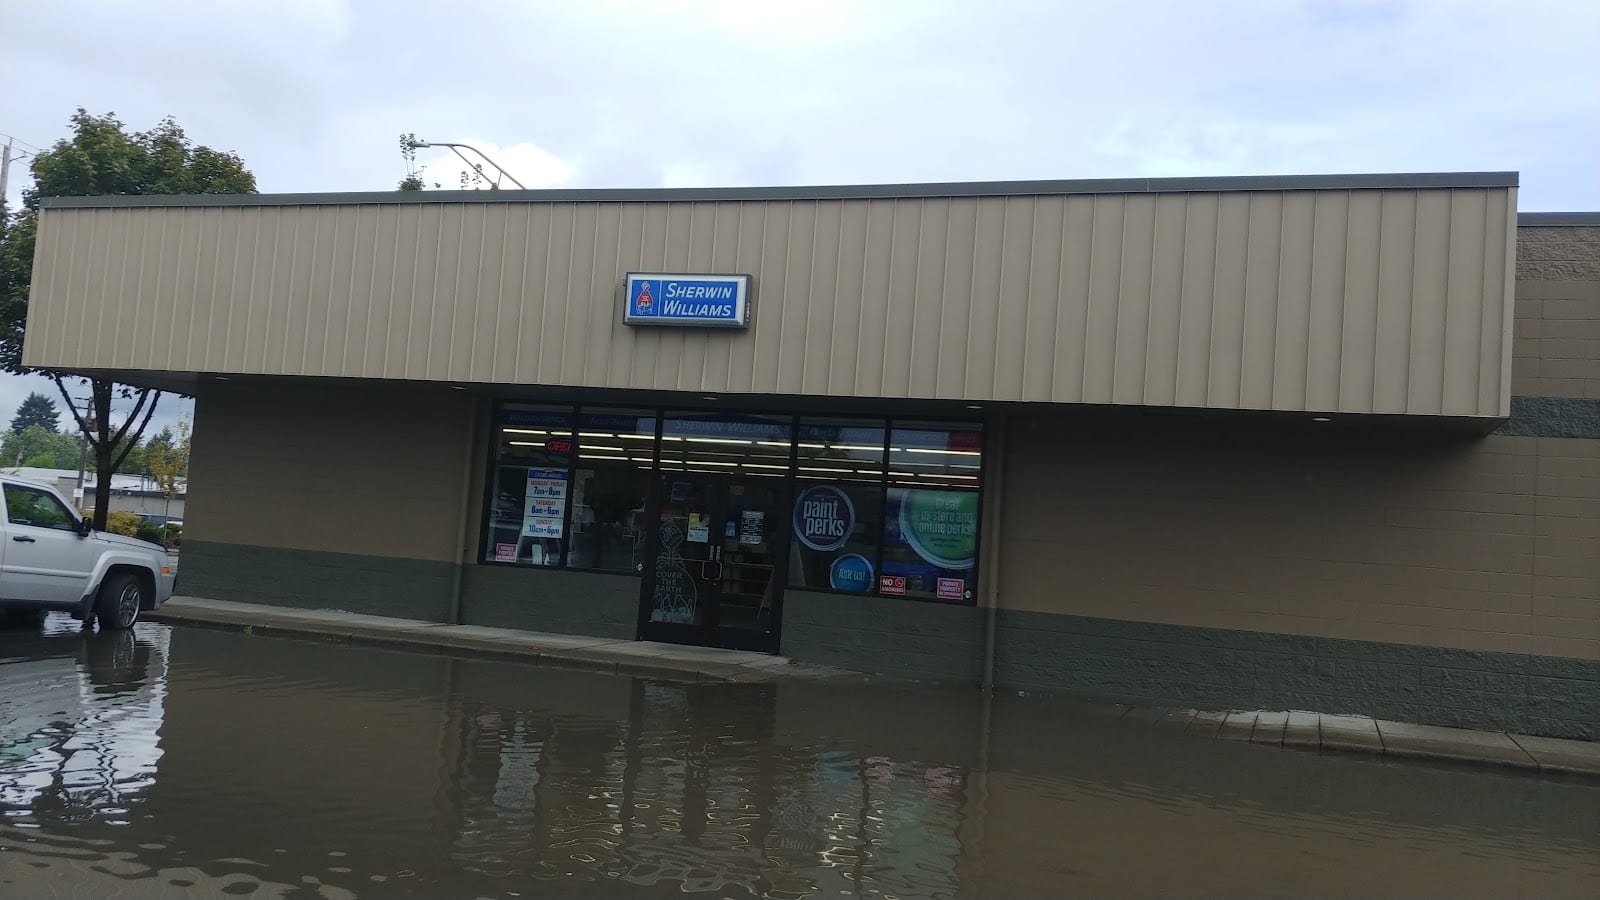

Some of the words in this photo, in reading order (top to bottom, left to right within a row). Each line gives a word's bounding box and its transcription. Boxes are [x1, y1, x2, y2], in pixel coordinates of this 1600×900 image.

[666, 283, 732, 299] SHERWIN
[663, 300, 732, 317] WILLIAMS
[803, 498, 838, 519] paint
[956, 512, 974, 523] and
[805, 518, 845, 537] perks
[919, 522, 946, 533] online
[882, 578, 893, 586] NO
[881, 586, 904, 594] SMOKING
